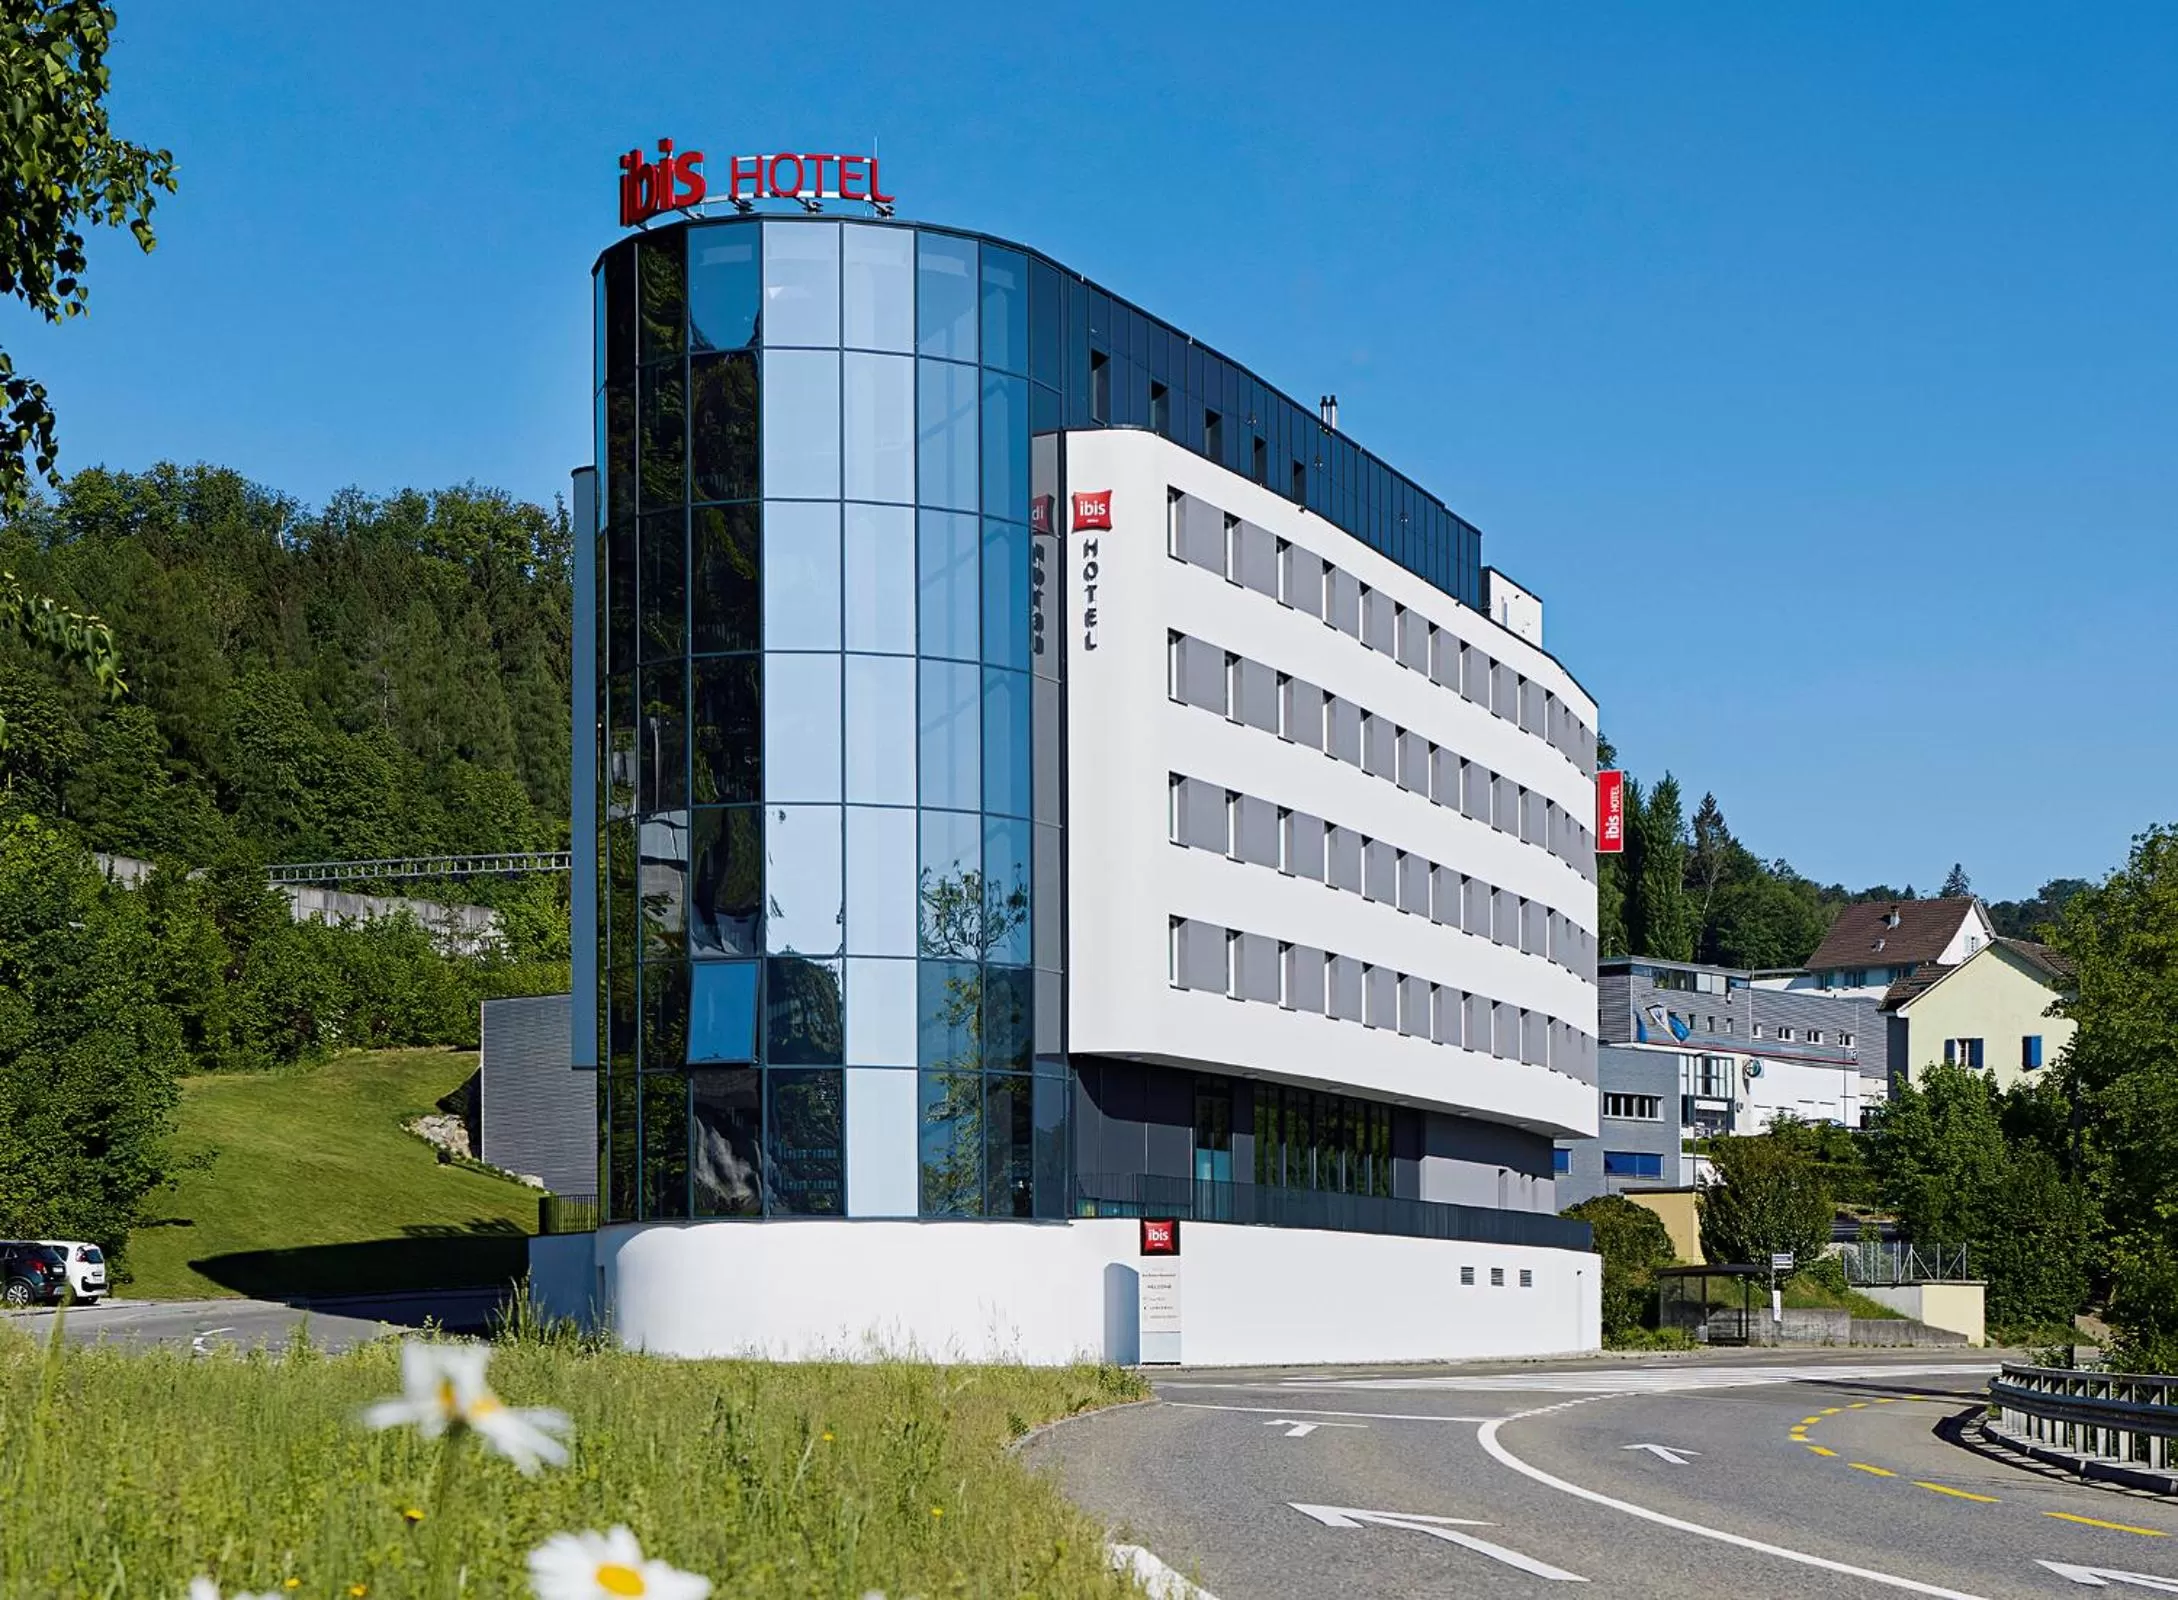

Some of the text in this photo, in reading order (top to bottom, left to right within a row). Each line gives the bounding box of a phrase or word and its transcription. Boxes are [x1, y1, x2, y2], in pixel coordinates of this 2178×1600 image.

[620, 138, 895, 226] ibis HOTEL
[1080, 500, 1106, 516] ibis
[1082, 538, 1099, 651] HOTEL
[1605, 784, 1620, 839] ibis HOTEL
[1148, 1228, 1169, 1241] ibis
